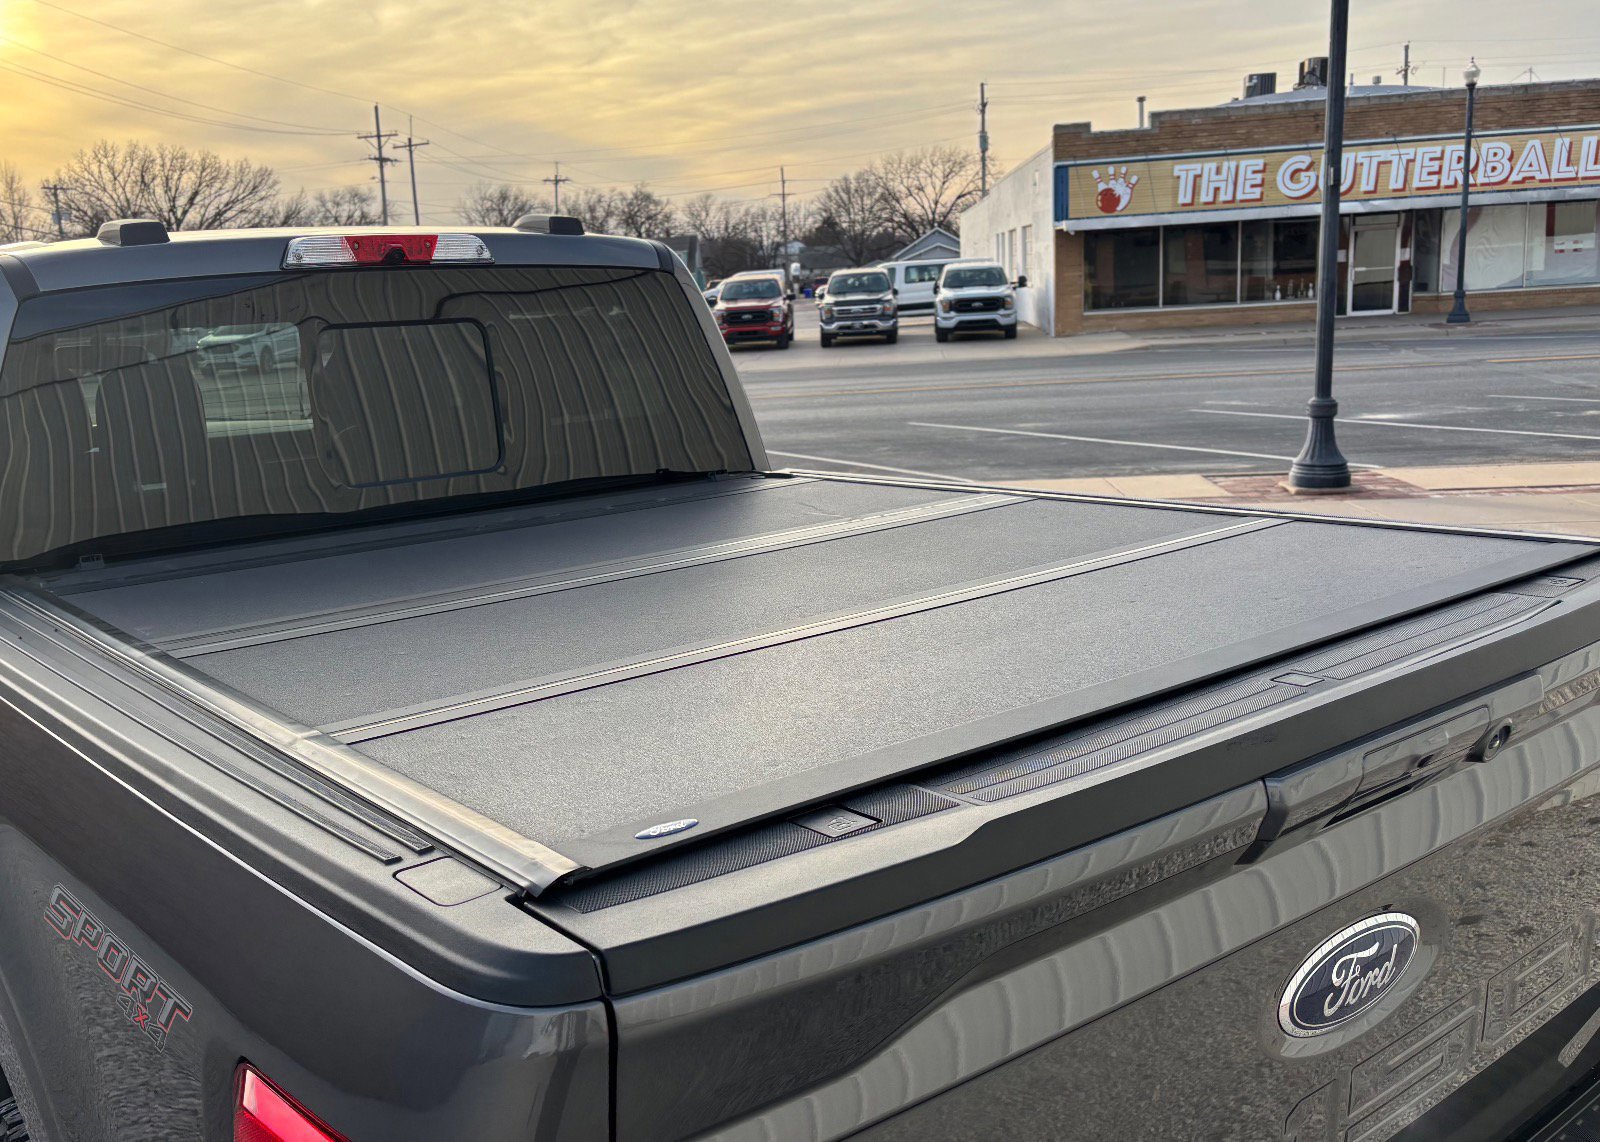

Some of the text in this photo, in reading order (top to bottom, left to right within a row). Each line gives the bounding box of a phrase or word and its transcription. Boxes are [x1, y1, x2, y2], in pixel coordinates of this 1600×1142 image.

[1173, 159, 1266, 205] THE
[44, 882, 193, 1033] SPORT
[1322, 941, 1398, 1018] Ford
